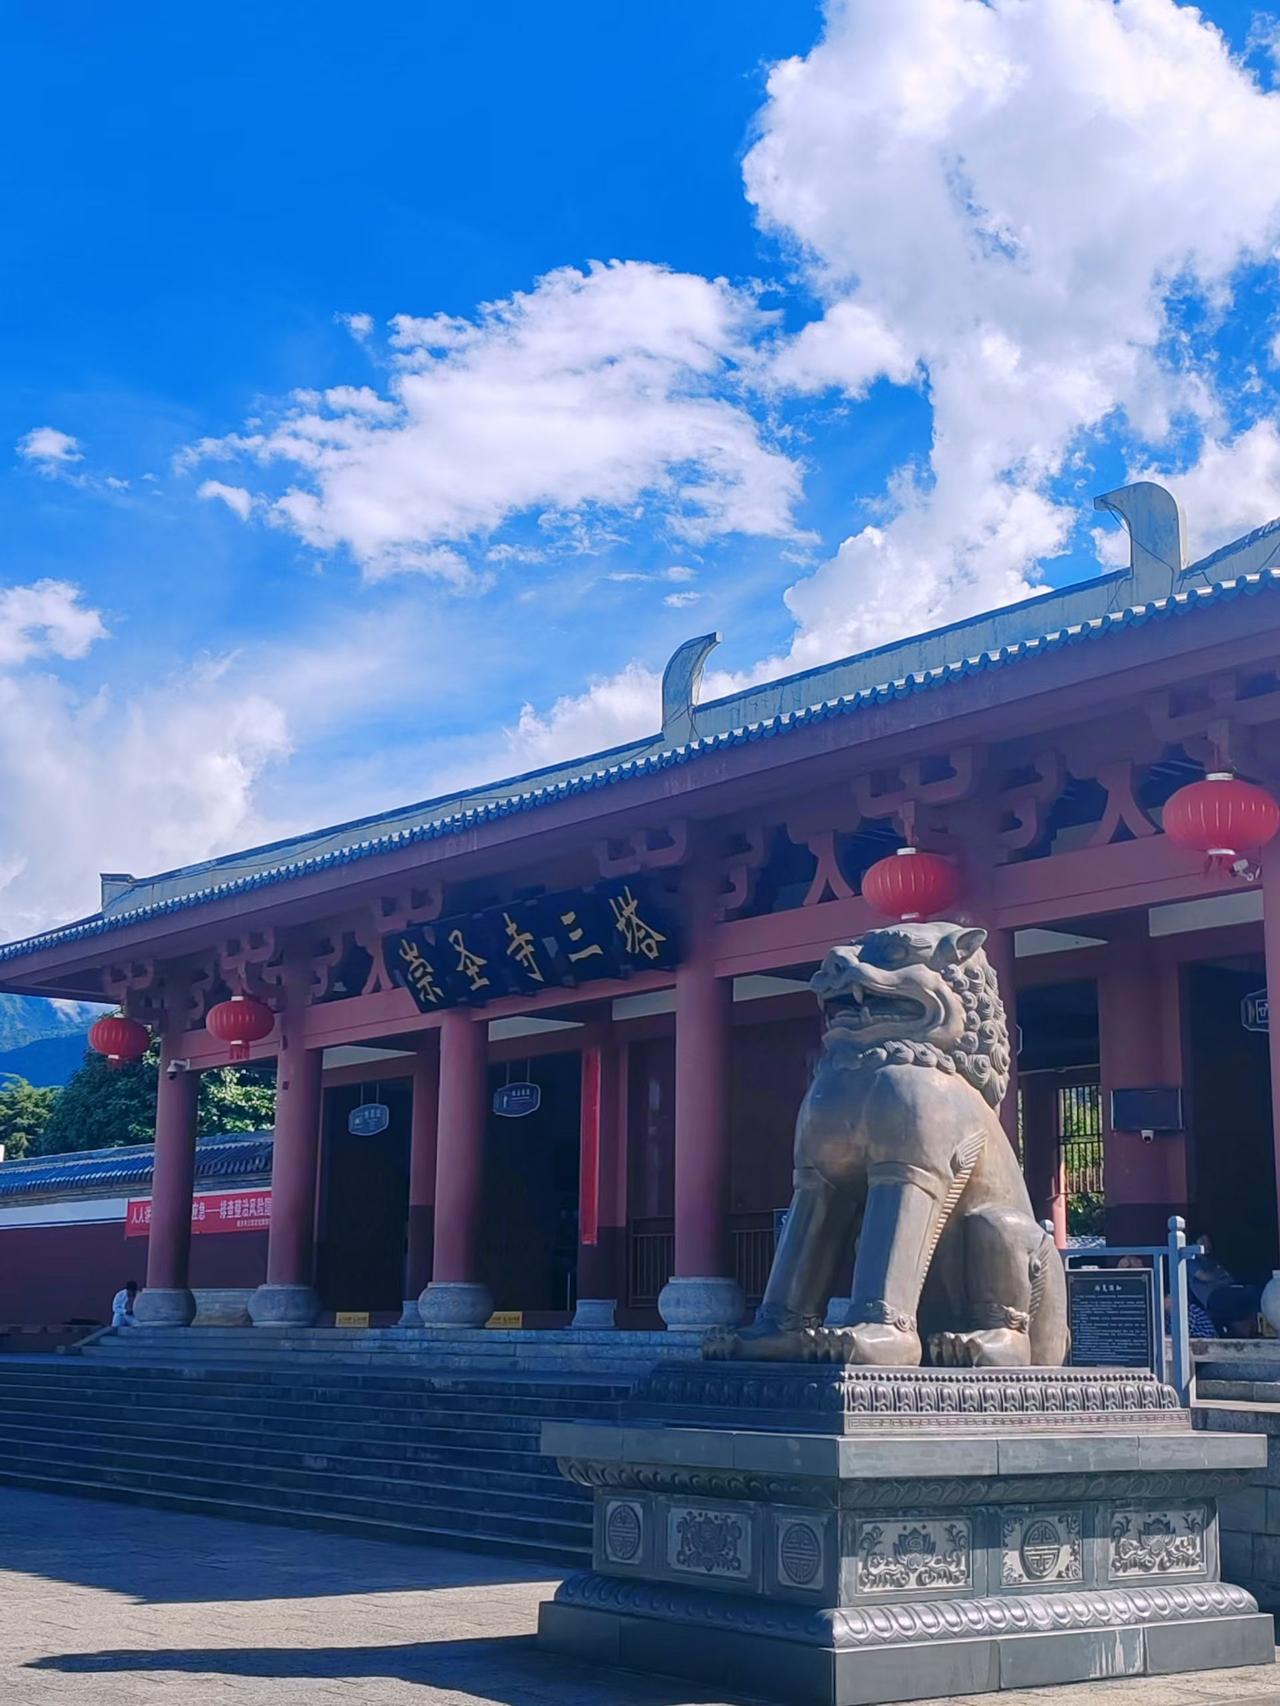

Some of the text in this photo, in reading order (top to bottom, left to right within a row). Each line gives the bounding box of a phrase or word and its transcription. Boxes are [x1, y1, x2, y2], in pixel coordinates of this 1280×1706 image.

[399, 886, 668, 1004] 崇圣寺三塔
